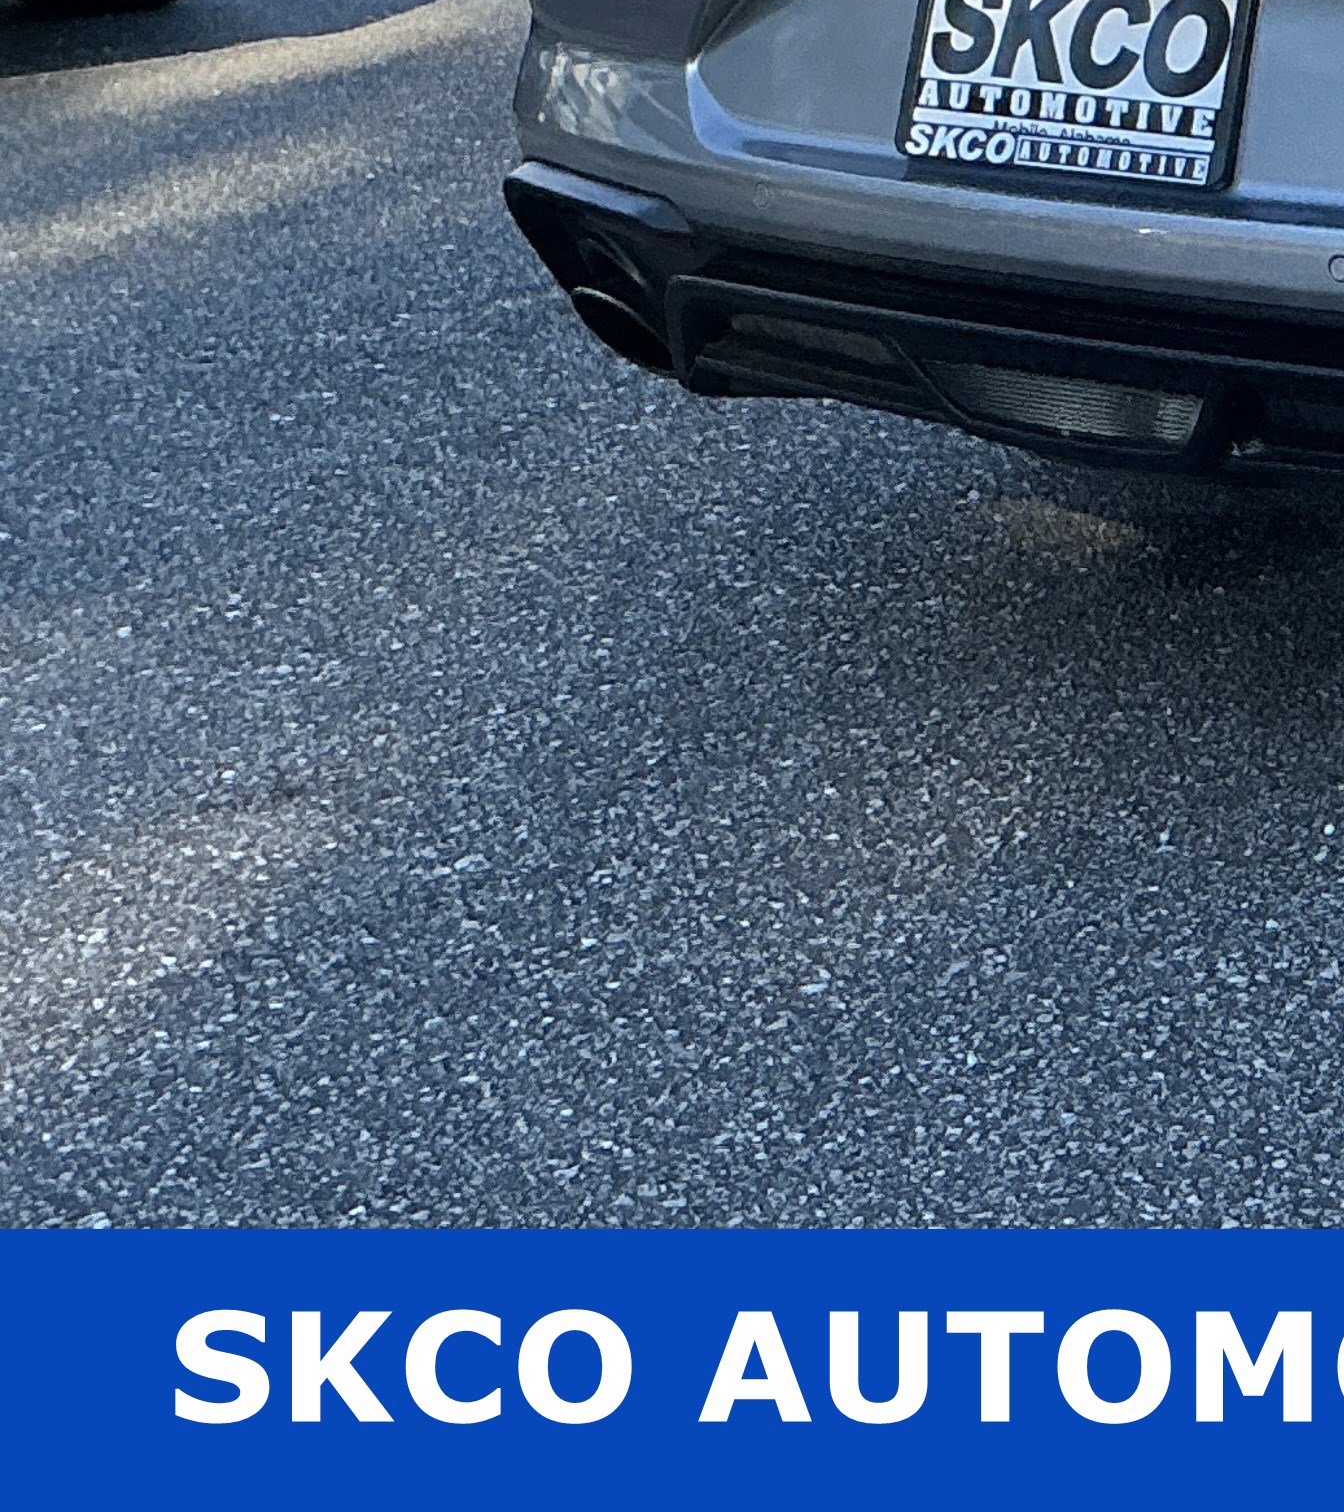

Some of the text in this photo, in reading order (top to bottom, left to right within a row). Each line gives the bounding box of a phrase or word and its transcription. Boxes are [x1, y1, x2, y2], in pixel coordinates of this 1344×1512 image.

[918, 79, 1216, 138] AUTOMOTIVE
[905, 123, 1208, 180] SKCO AUTOMOTIVE
